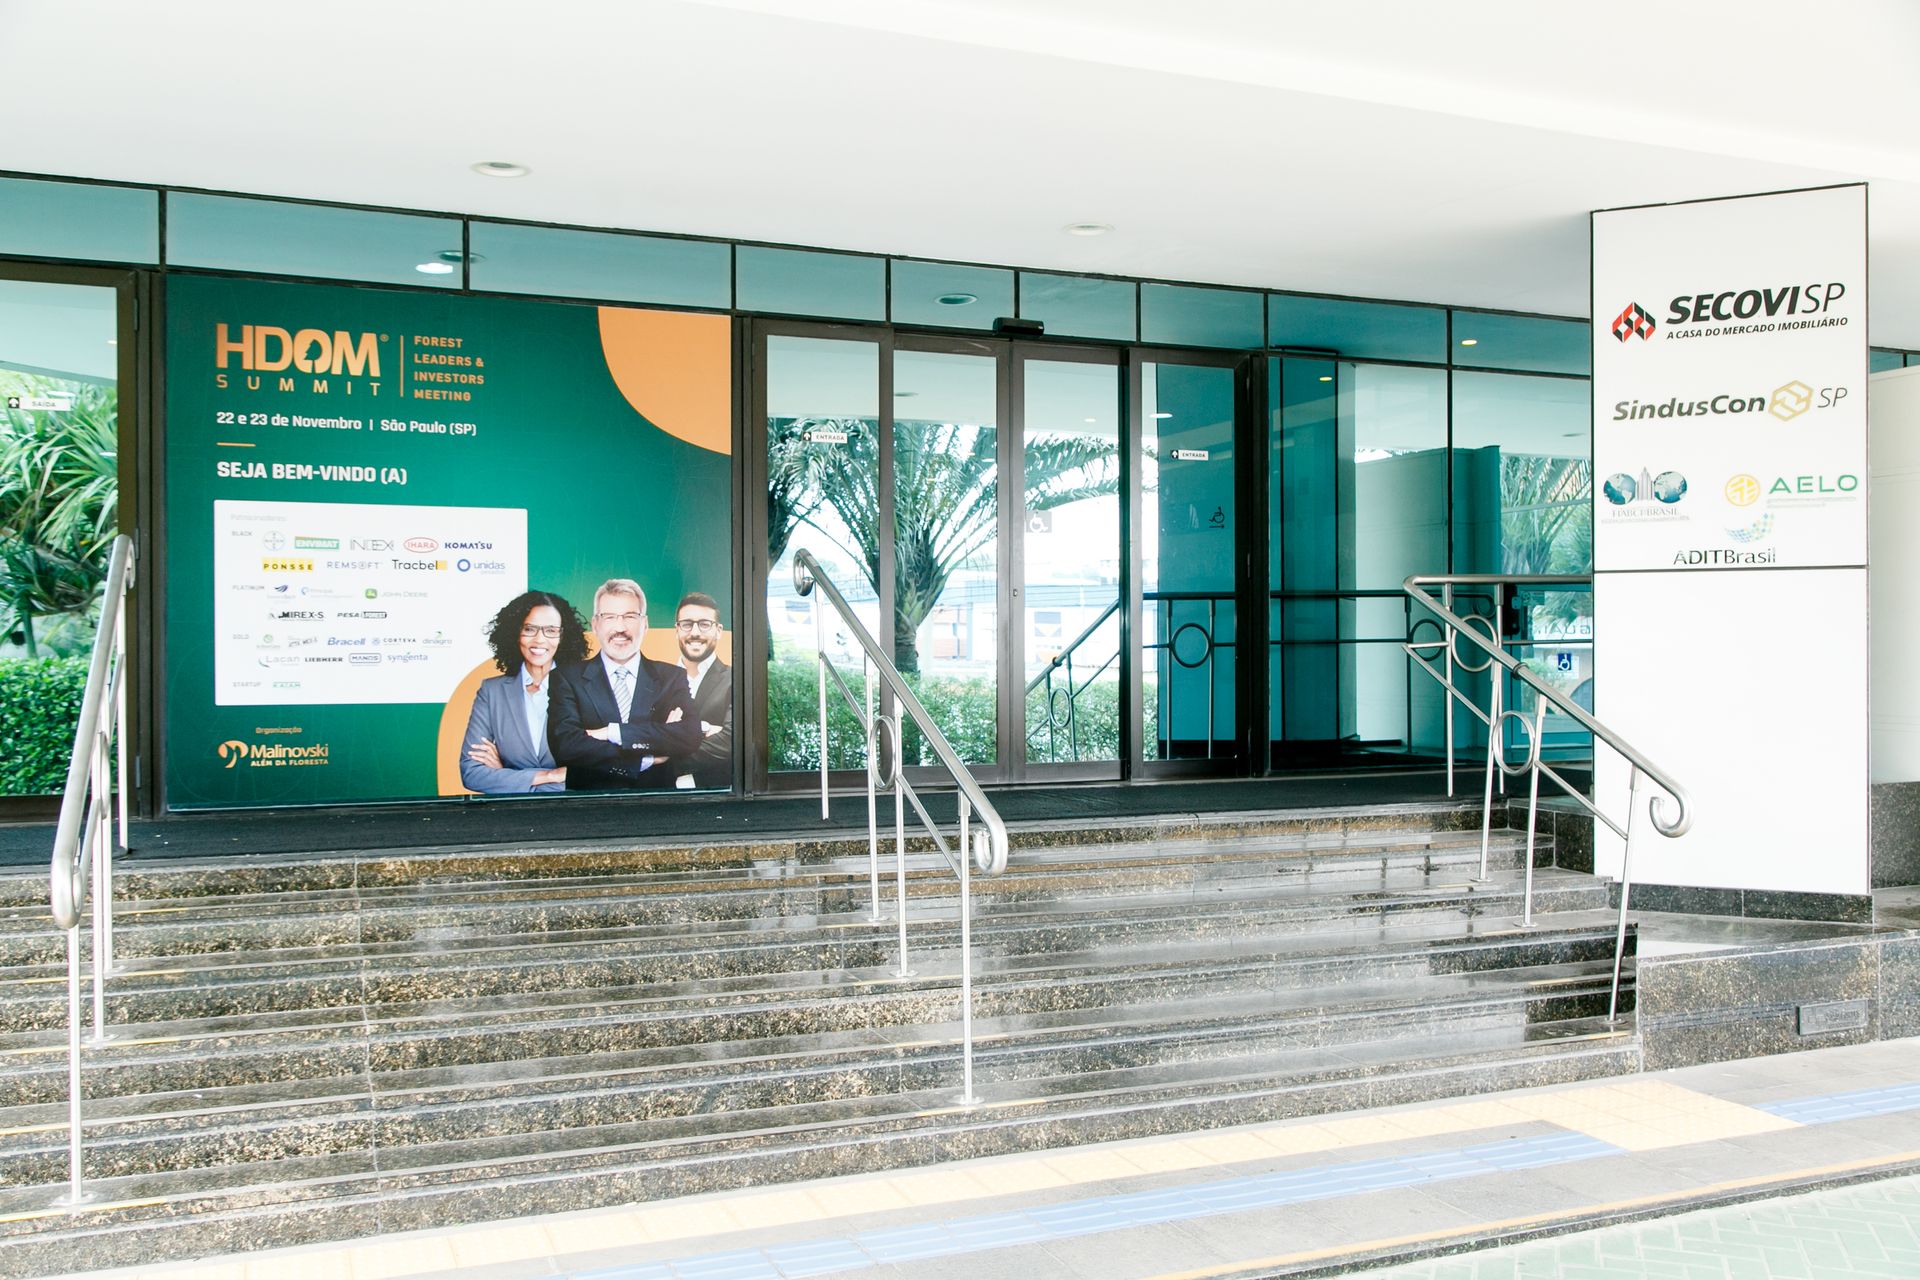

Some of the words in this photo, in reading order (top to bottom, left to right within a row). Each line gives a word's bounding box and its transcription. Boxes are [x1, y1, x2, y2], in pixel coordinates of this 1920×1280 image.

[1666, 331, 1675, 340] A
[1676, 329, 1703, 339] CASA
[1705, 327, 1721, 337] DO
[1722, 323, 1776, 335] MERCADO
[1777, 316, 1849, 331] IMOBILIÁRIO
[414, 335, 463, 349] FOREST
[414, 353, 472, 367] LEADERS
[475, 356, 485, 368] &
[216, 374, 381, 397] SUMMIT
[414, 371, 485, 386] INVESTORS
[414, 388, 472, 402] MEETING
[1612, 393, 1766, 421] SindusCon
[1817, 386, 1848, 409] SP
[216, 411, 235, 425] 22
[237, 415, 247, 426] e
[250, 413, 268, 427] 23
[271, 413, 289, 428] de
[292, 415, 362, 431] Novembro
[380, 418, 406, 433] São
[409, 420, 447, 435] Paulo
[449, 422, 477, 437] (SP)
[216, 461, 267, 479] SEJA
[271, 463, 376, 483] BEM-VINDO
[380, 467, 408, 486] (A)
[1768, 474, 1858, 495] AELO
[444, 541, 493, 550] KOMATSU
[1673, 547, 1776, 566] ADITBrasil
[263, 563, 313, 571] PONSSE
[392, 559, 438, 571] Tracbel
[473, 559, 506, 570] unidas
[327, 637, 366, 646] Bracell
[387, 653, 429, 664] syngenta
[250, 744, 329, 758] Malinovski
[250, 758, 273, 767] ALÉM
